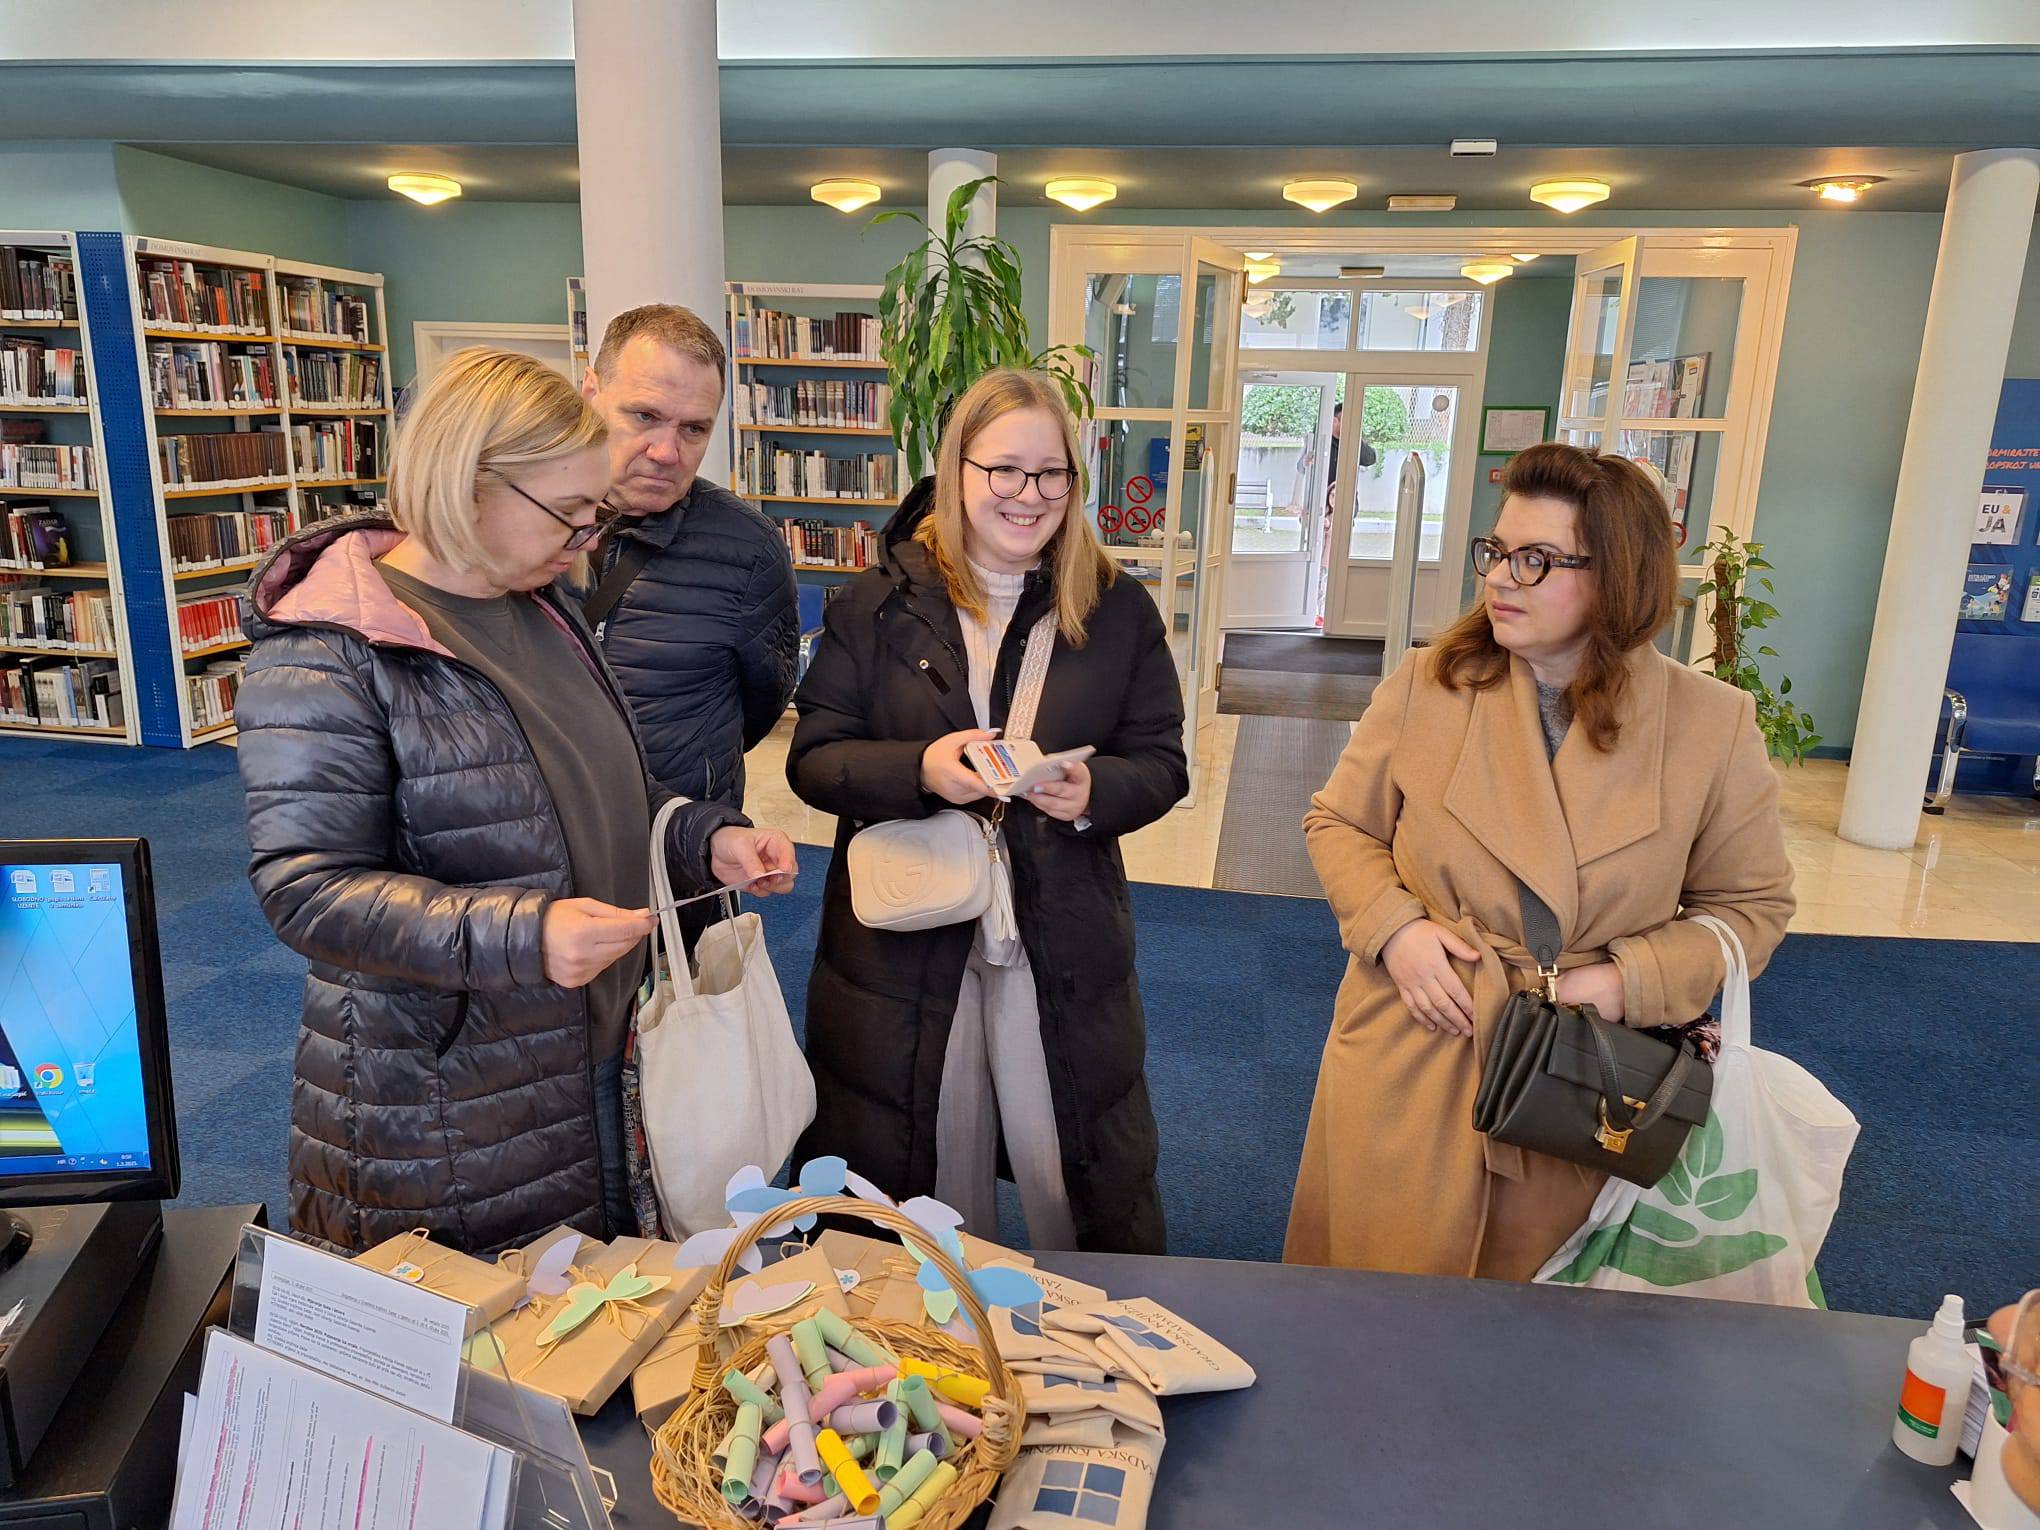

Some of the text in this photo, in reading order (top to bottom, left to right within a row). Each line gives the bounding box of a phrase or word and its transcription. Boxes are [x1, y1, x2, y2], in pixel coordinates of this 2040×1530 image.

[1982, 504, 2012, 514] EU &
[1979, 516, 2006, 533] JA
